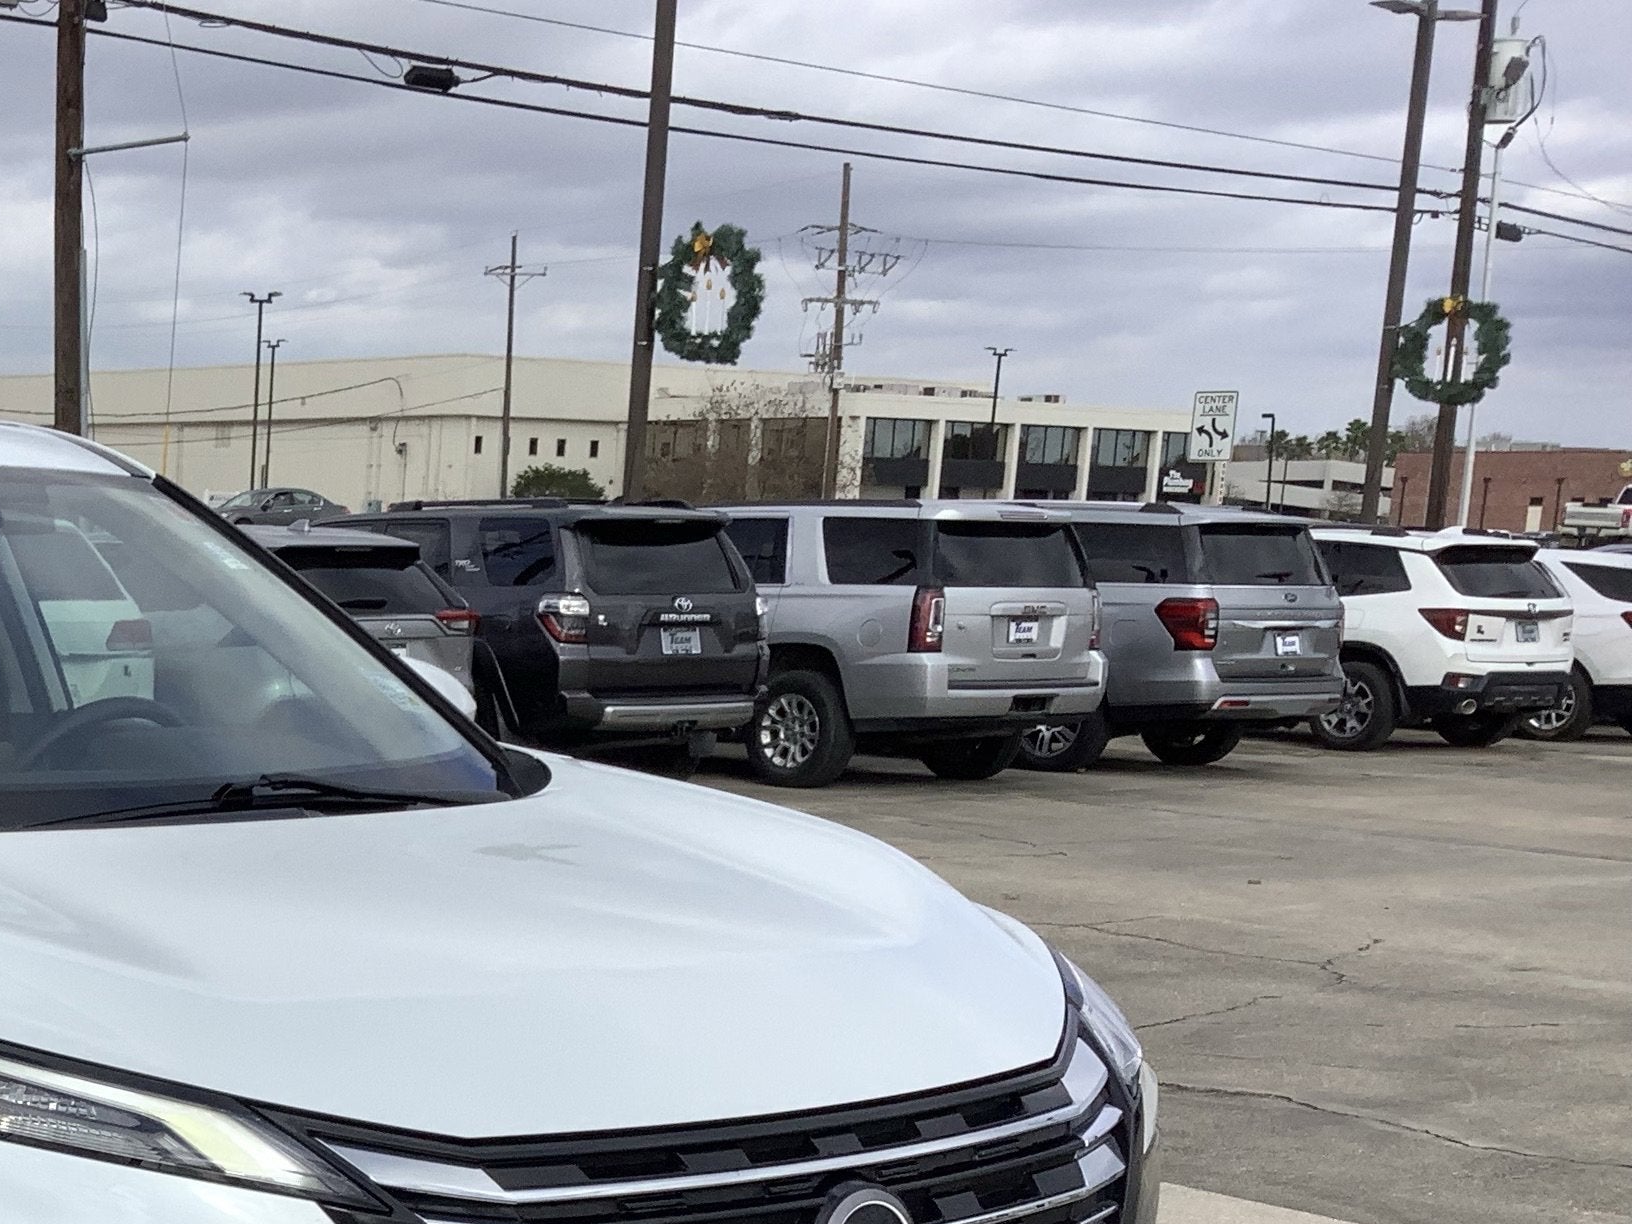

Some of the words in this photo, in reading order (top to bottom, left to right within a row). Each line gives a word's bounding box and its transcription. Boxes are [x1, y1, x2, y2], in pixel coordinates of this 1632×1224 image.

[1198, 395, 1235, 405] CENTER
[1202, 405, 1228, 414] LANE
[1197, 448, 1223, 458] ONLY
[1014, 621, 1033, 634] TEAM
